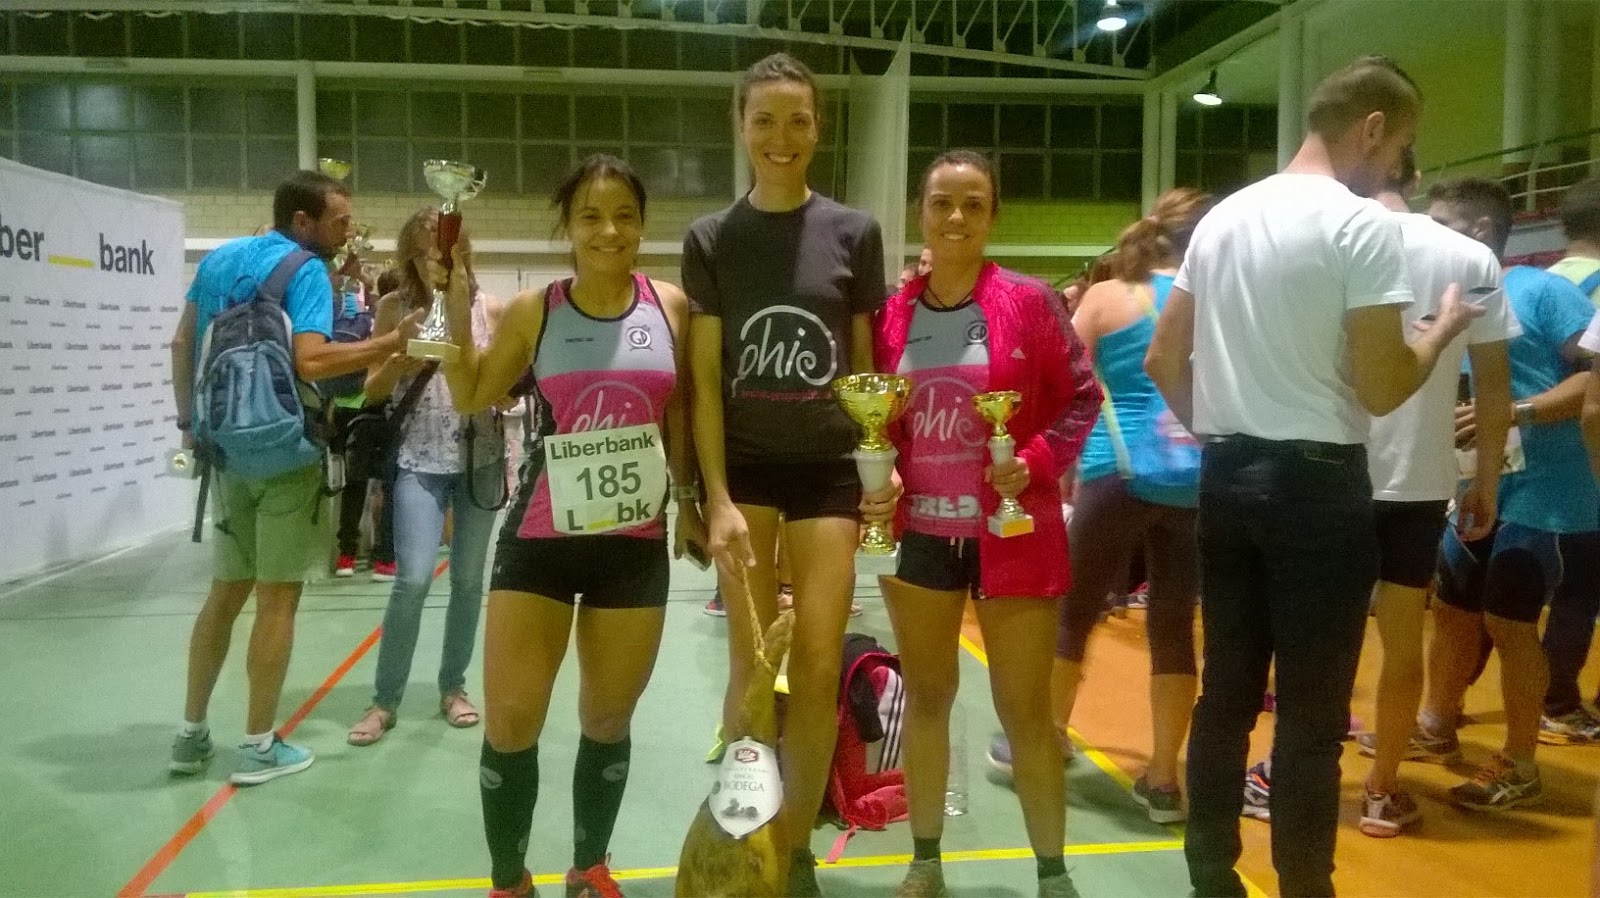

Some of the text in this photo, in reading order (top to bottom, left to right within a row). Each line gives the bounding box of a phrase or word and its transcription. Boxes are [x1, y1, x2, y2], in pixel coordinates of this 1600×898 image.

[99, 232, 155, 275] bank
[550, 432, 655, 461] Liberbank
[576, 461, 642, 501] 185
[567, 498, 651, 532] L bk
